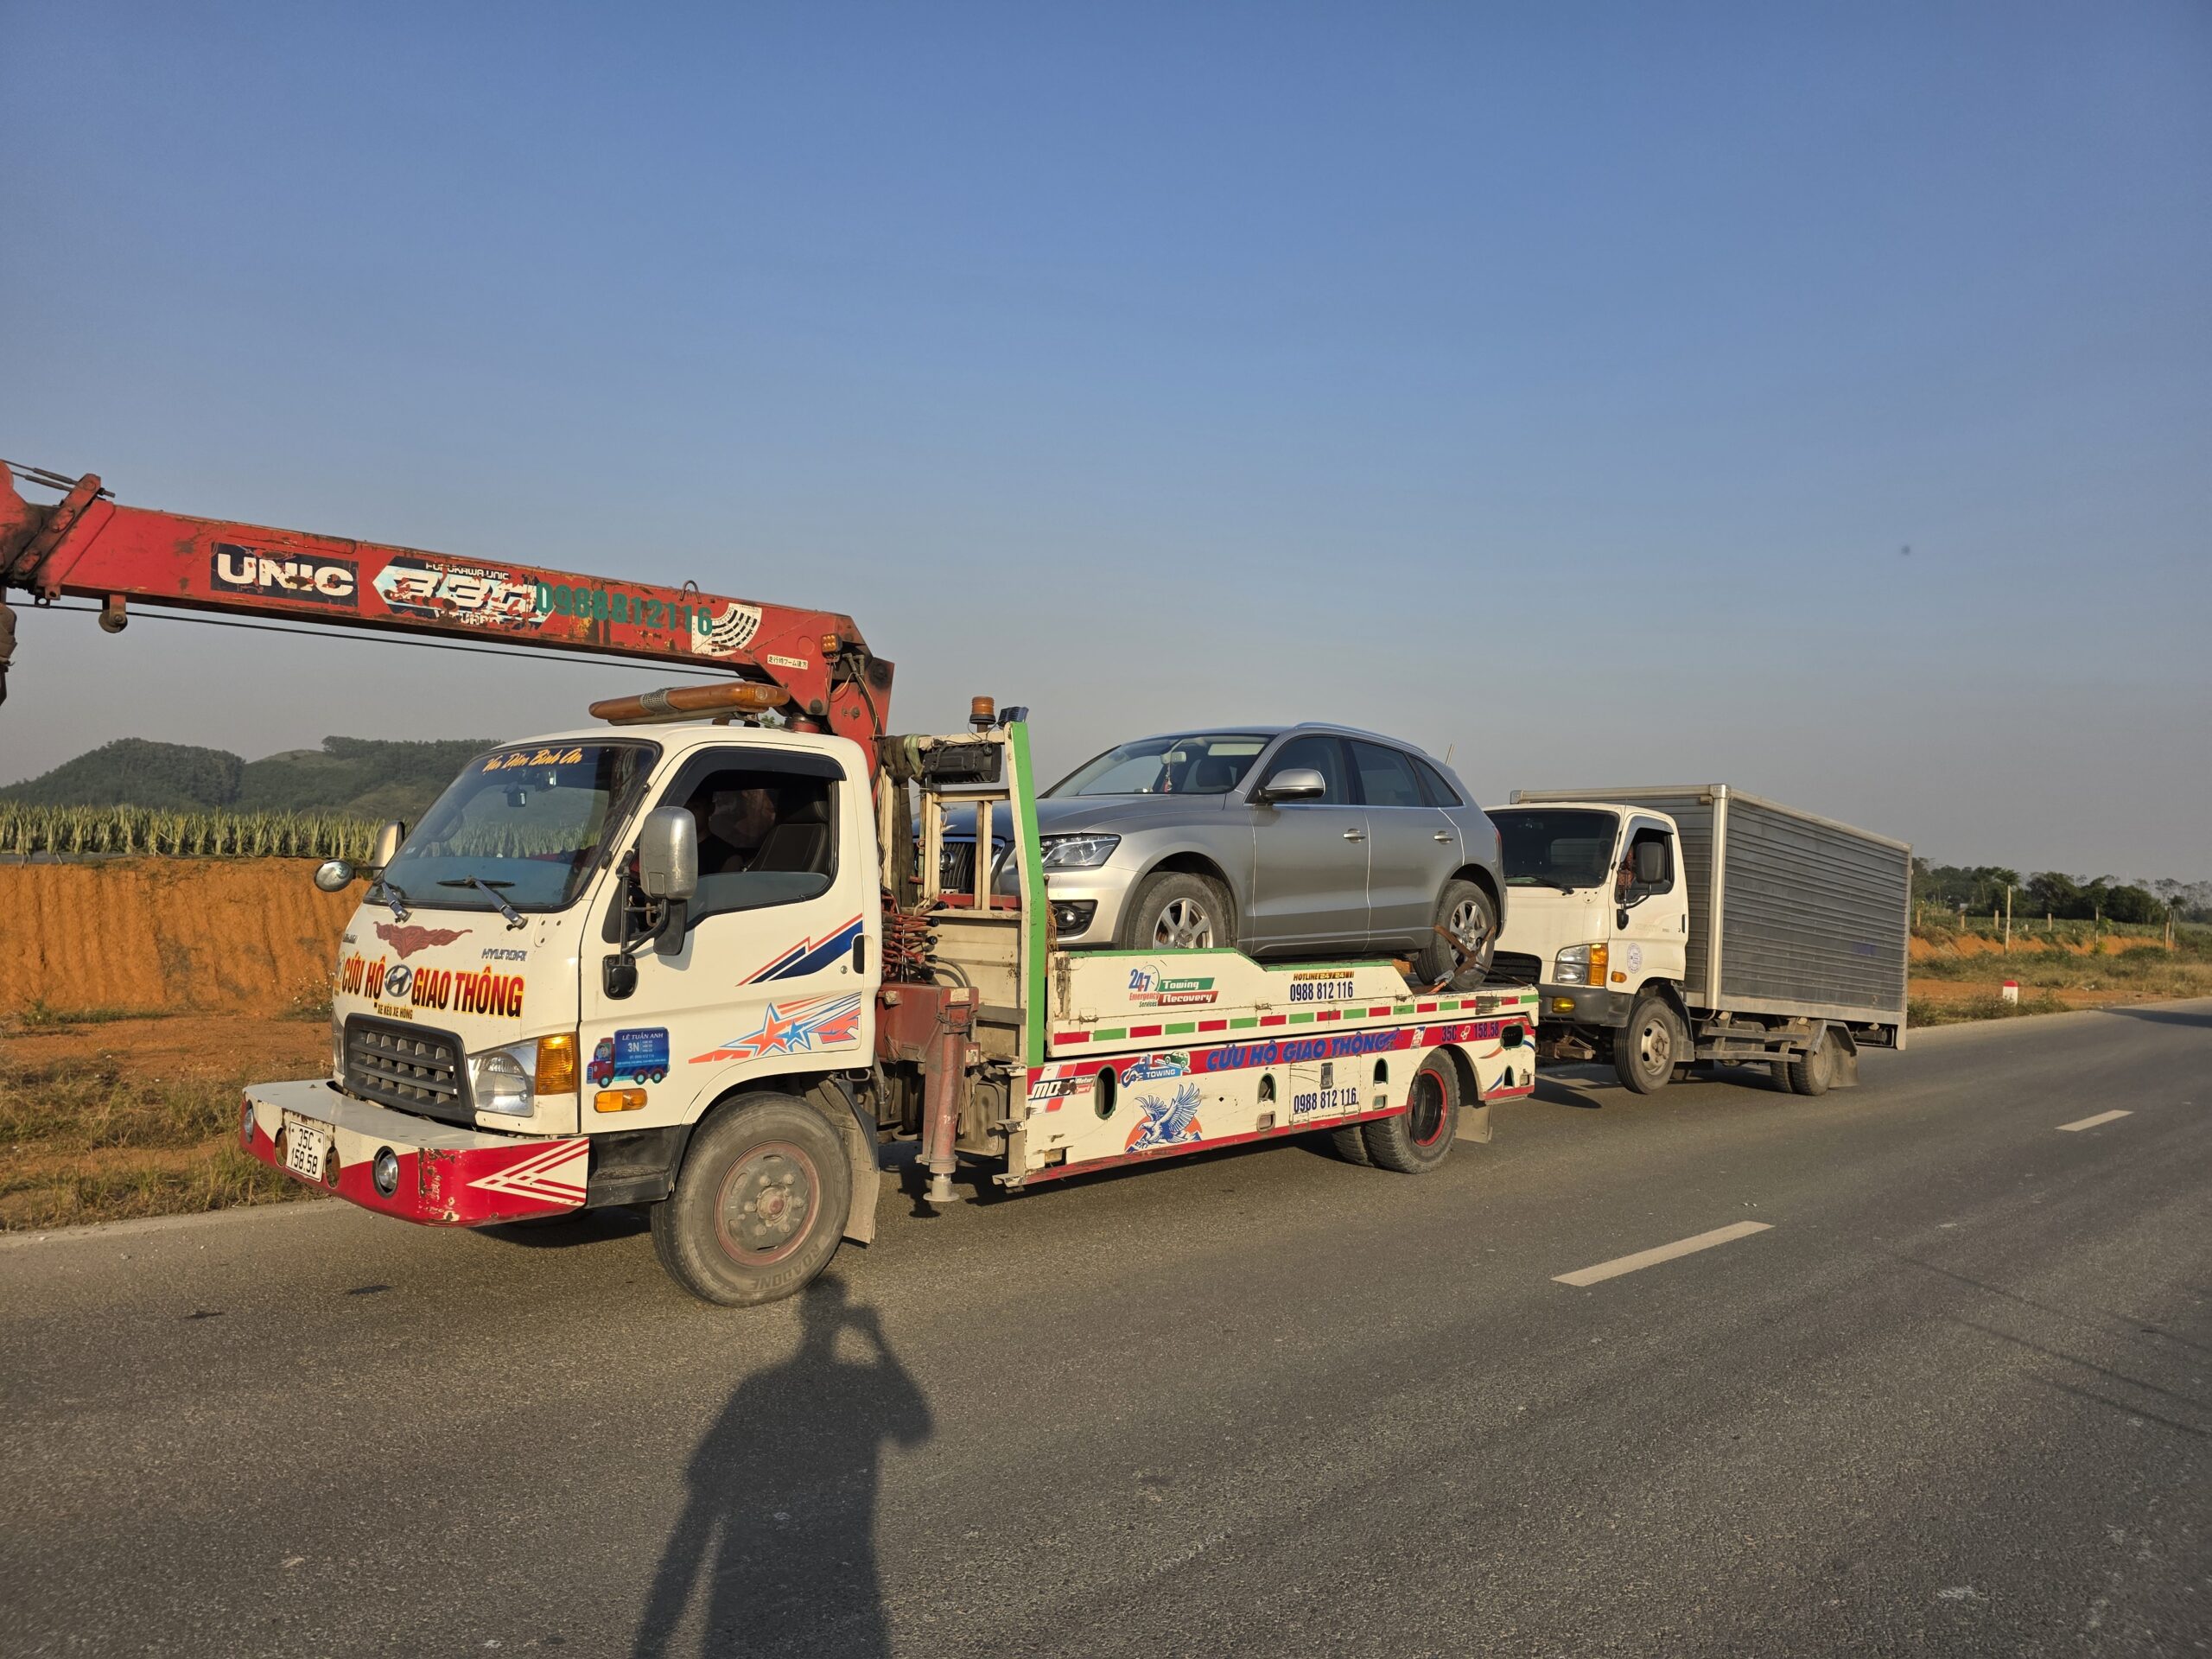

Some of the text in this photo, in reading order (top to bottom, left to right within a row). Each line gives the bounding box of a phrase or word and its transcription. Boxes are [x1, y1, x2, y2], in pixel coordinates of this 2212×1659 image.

[217, 553, 353, 596] UNIC
[536, 582, 713, 636] 0988812116
[481, 948, 528, 962] HYUNDAI
[1162, 980, 1199, 989] Towing
[1294, 972, 1319, 981] HOTLINE
[410, 967, 452, 1010] GIAO
[453, 964, 524, 1017] THÔNG
[1129, 992, 1159, 1001] Emergency
[1162, 994, 1213, 1003] Recovery
[1290, 981, 1353, 1001] 0988 812 116
[392, 1007, 398, 1017] XE
[1441, 1021, 1499, 1041] 35C 158.58
[627, 1042, 639, 1052] 3N
[1207, 1031, 1389, 1071] CỨU HỘ GIAO THÔNG
[1146, 1069, 1176, 1078] TOWING
[1294, 1087, 1357, 1113] 0988 812 116
[297, 1128, 315, 1151] 35C
[291, 1147, 318, 1175] 158.58
